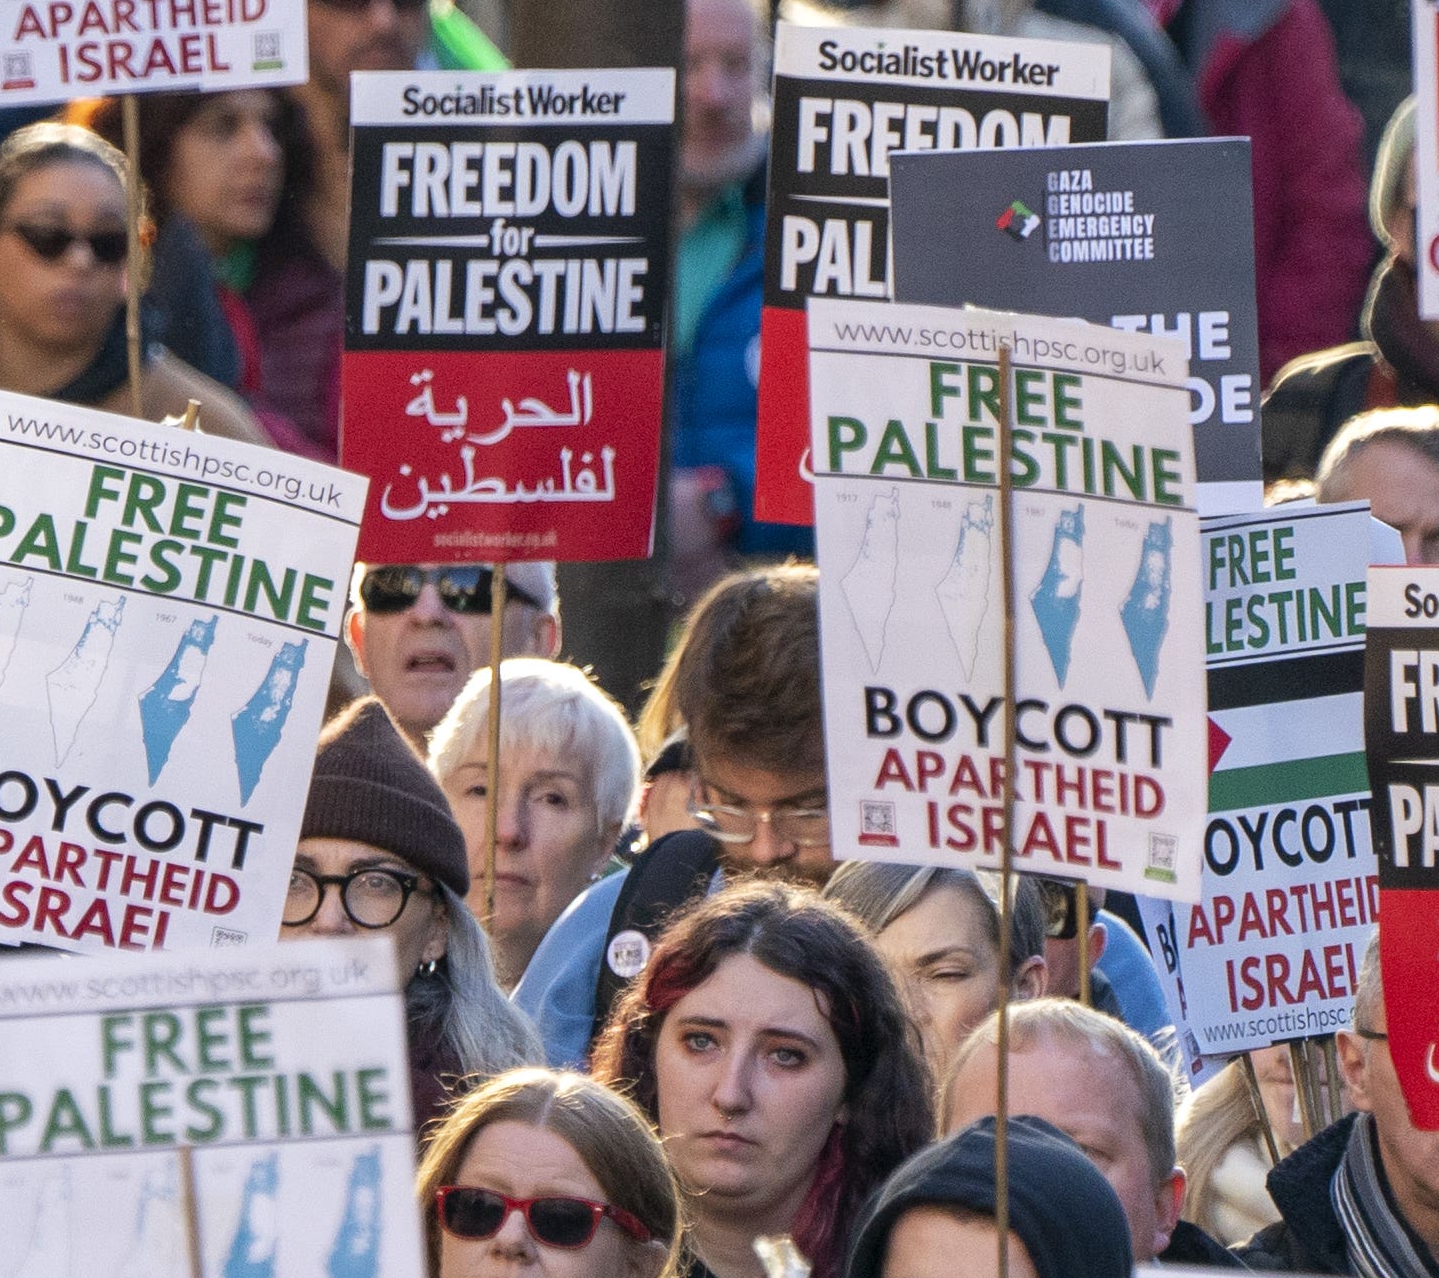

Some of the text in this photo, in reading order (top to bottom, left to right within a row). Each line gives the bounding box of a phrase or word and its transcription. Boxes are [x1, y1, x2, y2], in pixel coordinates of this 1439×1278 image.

[58, 33, 231, 86] ISRAEL
[380, 140, 636, 219] FREEDOM
[1047, 170, 1092, 191] GAZA
[1048, 191, 1133, 215] GENOCIDE
[489, 221, 536, 257] for
[1049, 216, 1155, 240] EMERGENCY
[1049, 237, 1154, 263] COMMITTEE
[362, 259, 648, 335] PALESTINE
[831, 321, 1167, 376] www.scottishpsc.org.uk
[929, 360, 1083, 428] FREE
[6, 411, 344, 511] www.scottishpsc.org.uk
[826, 417, 1183, 508] PALESTINE
[85, 465, 250, 550] FREE
[1208, 526, 1297, 591] FREE
[155, 612, 177, 624] 1967
[864, 688, 1173, 769] BOYCOTT
[875, 747, 1166, 821] APARTHEID
[928, 802, 1122, 871] ISRAEL
[101, 1000, 273, 1074] FREE
